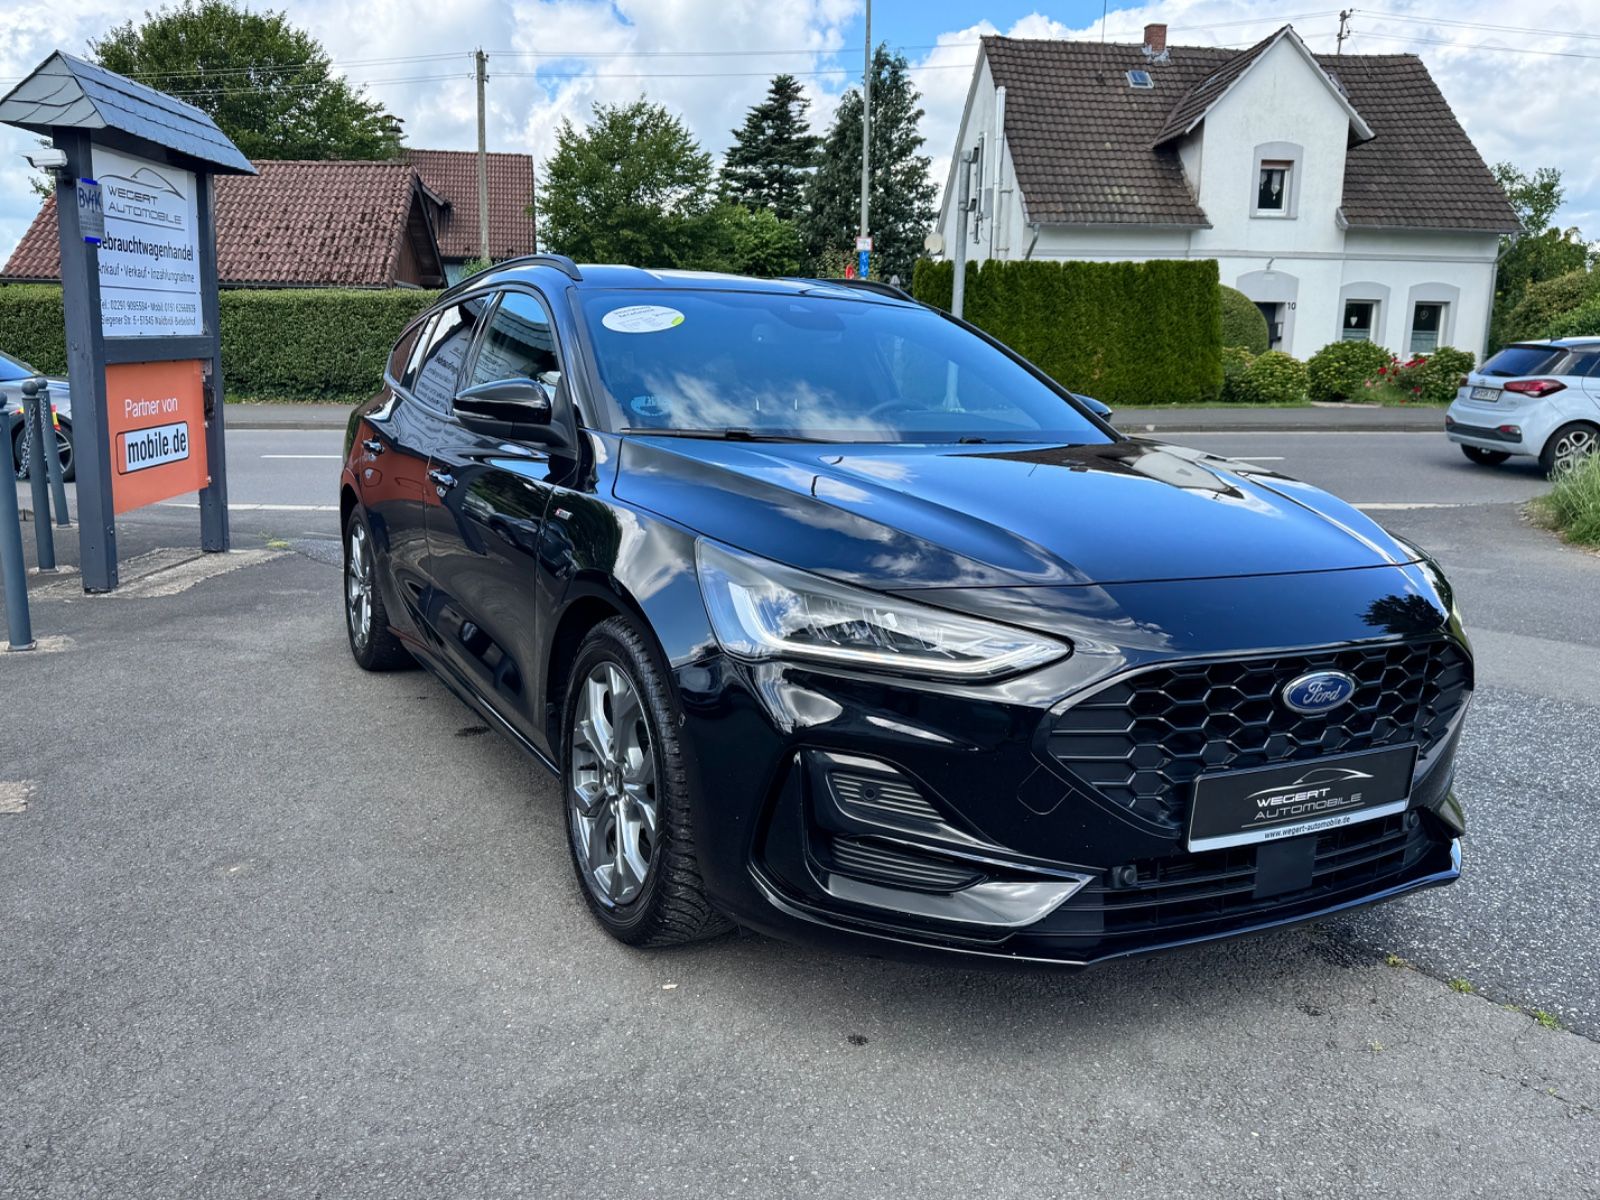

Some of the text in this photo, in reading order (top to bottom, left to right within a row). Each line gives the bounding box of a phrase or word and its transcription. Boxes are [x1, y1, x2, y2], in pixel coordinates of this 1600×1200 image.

[107, 185, 158, 206] WEGERT
[109, 202, 182, 224] AUTOMOBILE
[124, 264, 147, 278] Verkauf
[151, 268, 195, 284] Inzahlungnahme
[1287, 302, 1297, 311] 10
[125, 397, 178, 418] Partner von
[128, 429, 186, 463] mobile.de
[1303, 681, 1341, 704] Ford
[1254, 793, 1362, 820] AUTOMOBILE
[1256, 787, 1331, 808] WEGERT
[1264, 816, 1350, 839] www.wegert-automobile.de
